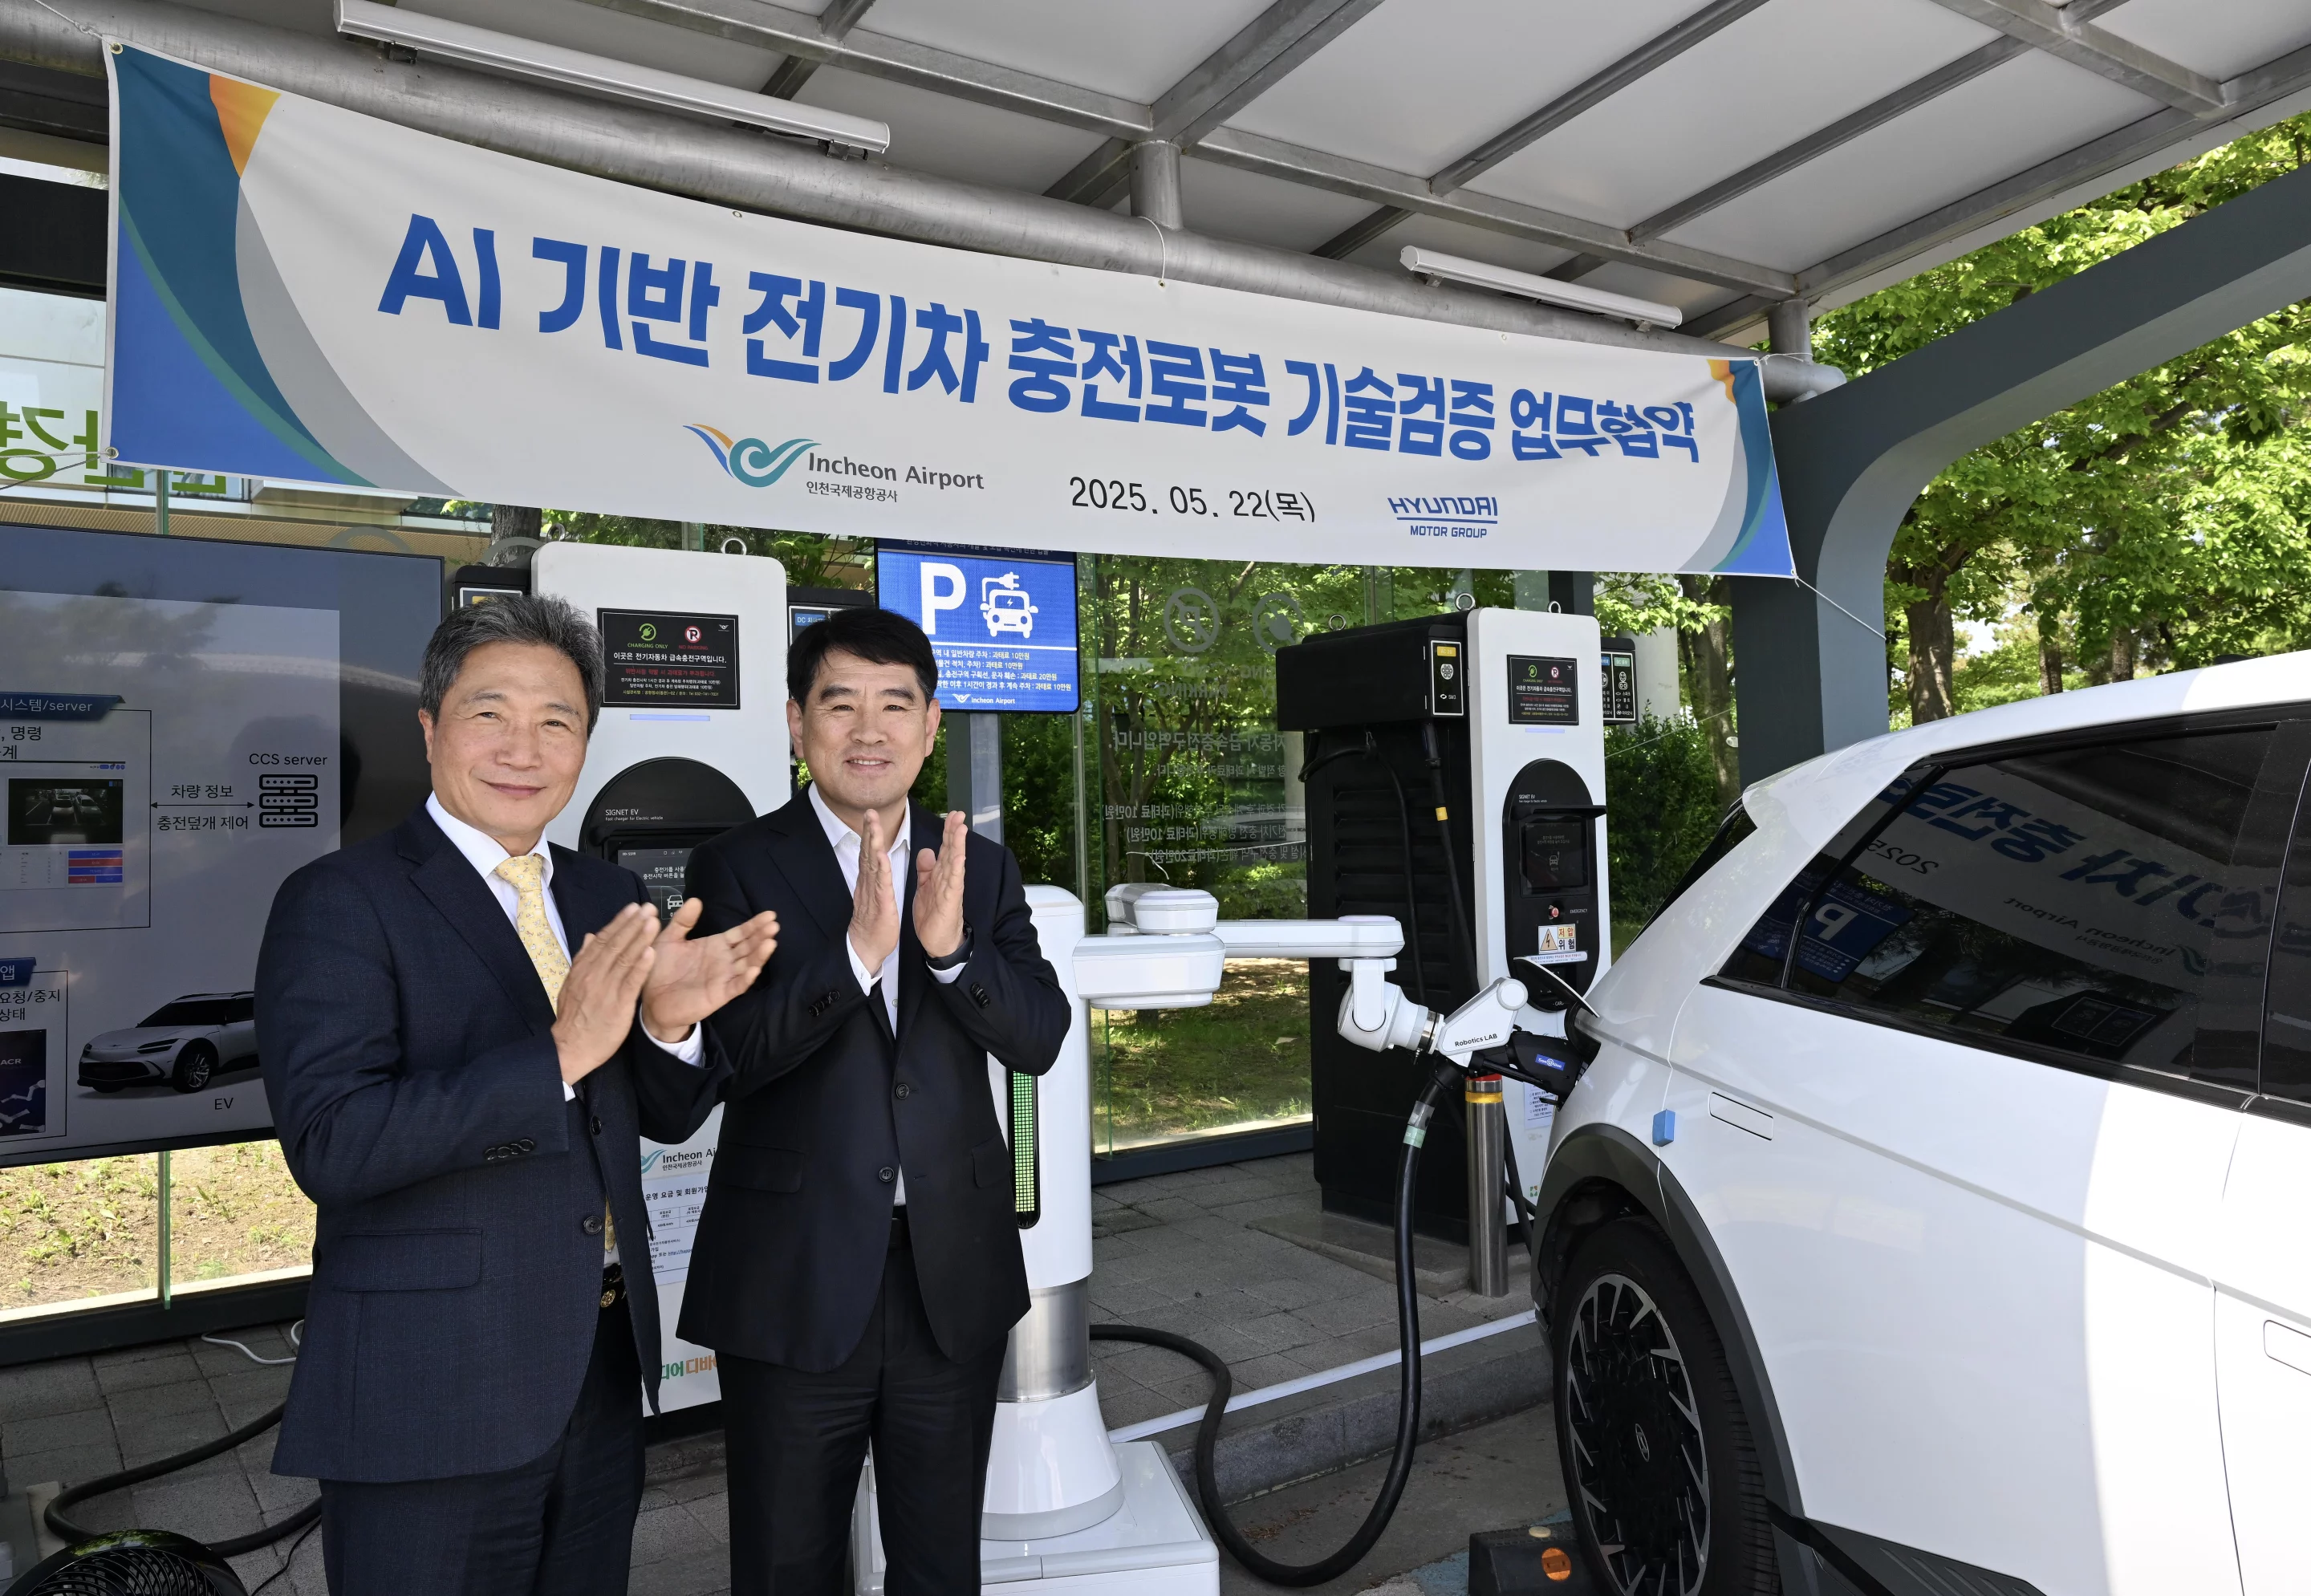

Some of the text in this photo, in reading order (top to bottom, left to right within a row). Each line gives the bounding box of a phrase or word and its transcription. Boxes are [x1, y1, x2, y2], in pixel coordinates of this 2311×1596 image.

[378, 213, 1700, 464] AI 기반 전기차 충전로봇 기술검증 업무협약
[808, 452, 985, 489] Incheon Airport
[805, 481, 899, 503] 인천국제공항공사
[1070, 477, 1316, 523] 2025. 05. 22(목)
[1387, 497, 1498, 517] HYUNDAI
[1410, 525, 1488, 538] MOTOR GROUP
[920, 562, 967, 635] P
[613, 652, 727, 664] 이곳은 전기자동차 급속충전구역입니다.
[943, 650, 1030, 660] 내 일반차량 주차 과태료 10만원
[986, 662, 1003, 670] 과태료
[945, 670, 969, 679] 충전구역
[1021, 672, 1038, 680] 과태료
[1038, 673, 1058, 681] 20만원
[950, 680, 962, 688] 이후
[964, 681, 985, 689] 1시간이
[986, 682, 998, 690] 경과
[1019, 683, 1031, 691] 주차
[1035, 684, 1053, 692] 과태료
[1054, 684, 1072, 692] 10만원
[1, 698, 93, 713] 시스템/server
[995, 697, 1016, 705] Airport
[11, 726, 43, 741] 명령
[249, 753, 328, 766] CCS server
[171, 784, 234, 799] 차량 정보
[156, 815, 249, 831] 충전덮개 제어
[654, 866, 673, 874] 충전기를
[1454, 1033, 1497, 1047] Robotics LAB
[213, 1097, 234, 1111] EV
[662, 1151, 703, 1163] Incheon
[662, 1159, 703, 1171] 인천국제공항공사
[645, 1192, 658, 1201] 운영
[660, 1190, 674, 1199] 요금
